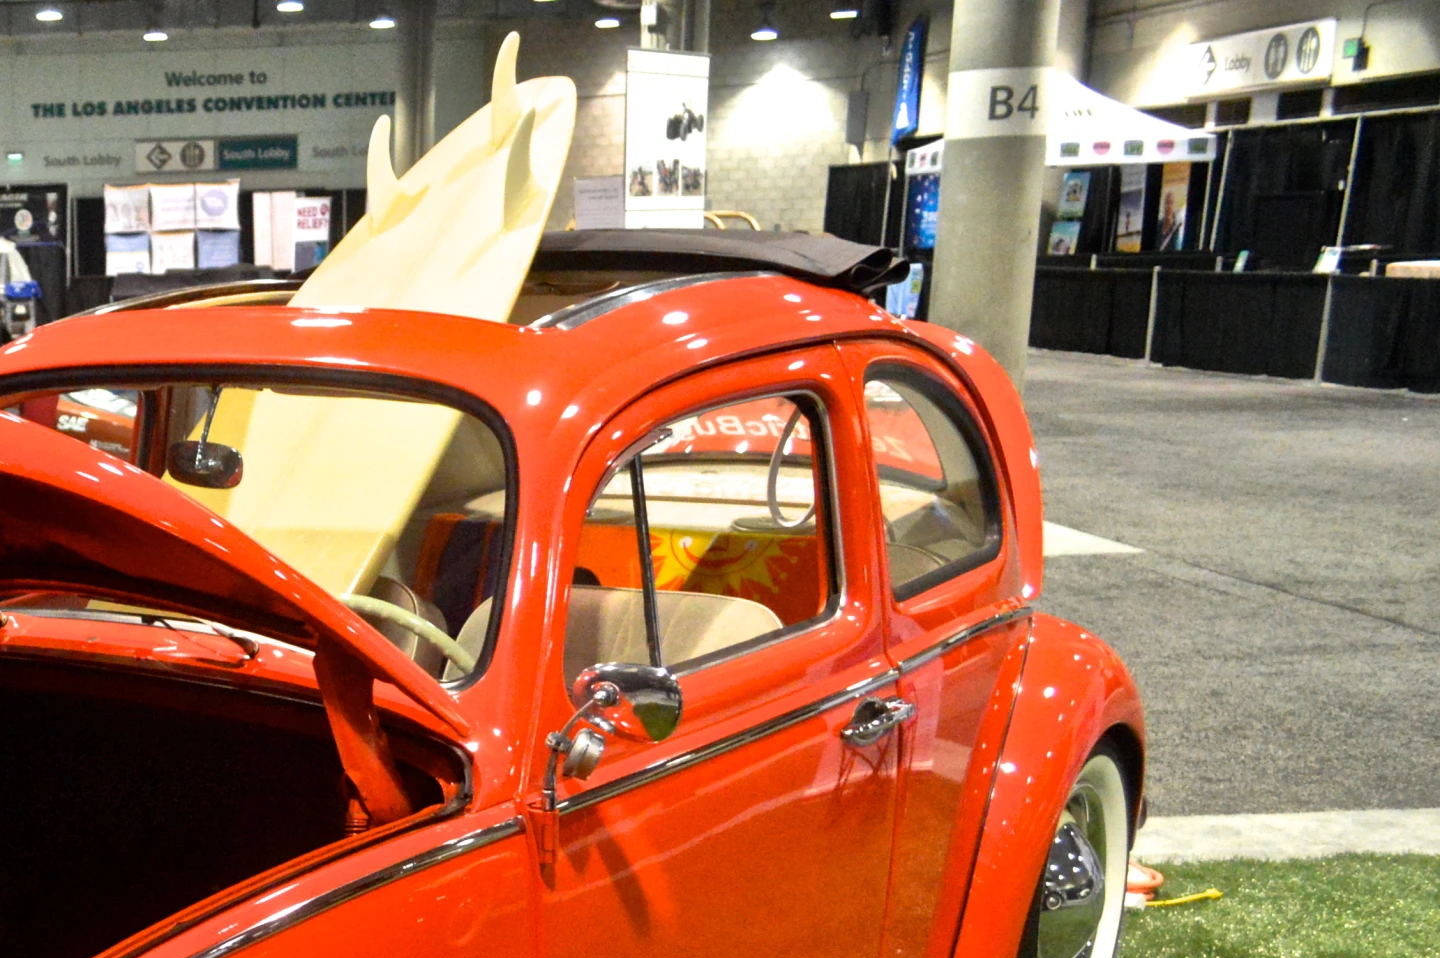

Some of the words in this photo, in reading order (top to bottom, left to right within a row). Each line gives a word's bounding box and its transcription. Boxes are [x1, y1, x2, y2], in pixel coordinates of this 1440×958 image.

[1223, 54, 1252, 72] Lobby
[164, 70, 244, 87] Welcome
[248, 70, 268, 85] to
[31, 102, 66, 118] THE
[71, 101, 107, 116] LOS
[113, 98, 197, 115] ANGELES
[203, 93, 327, 112] CONVENTION
[988, 84, 1039, 121] B4
[43, 154, 80, 167] South
[83, 153, 121, 168] Lobby
[223, 148, 255, 160] South
[258, 147, 291, 162] Lobby
[297, 206, 317, 217] NEED
[57, 414, 89, 432] SAE
